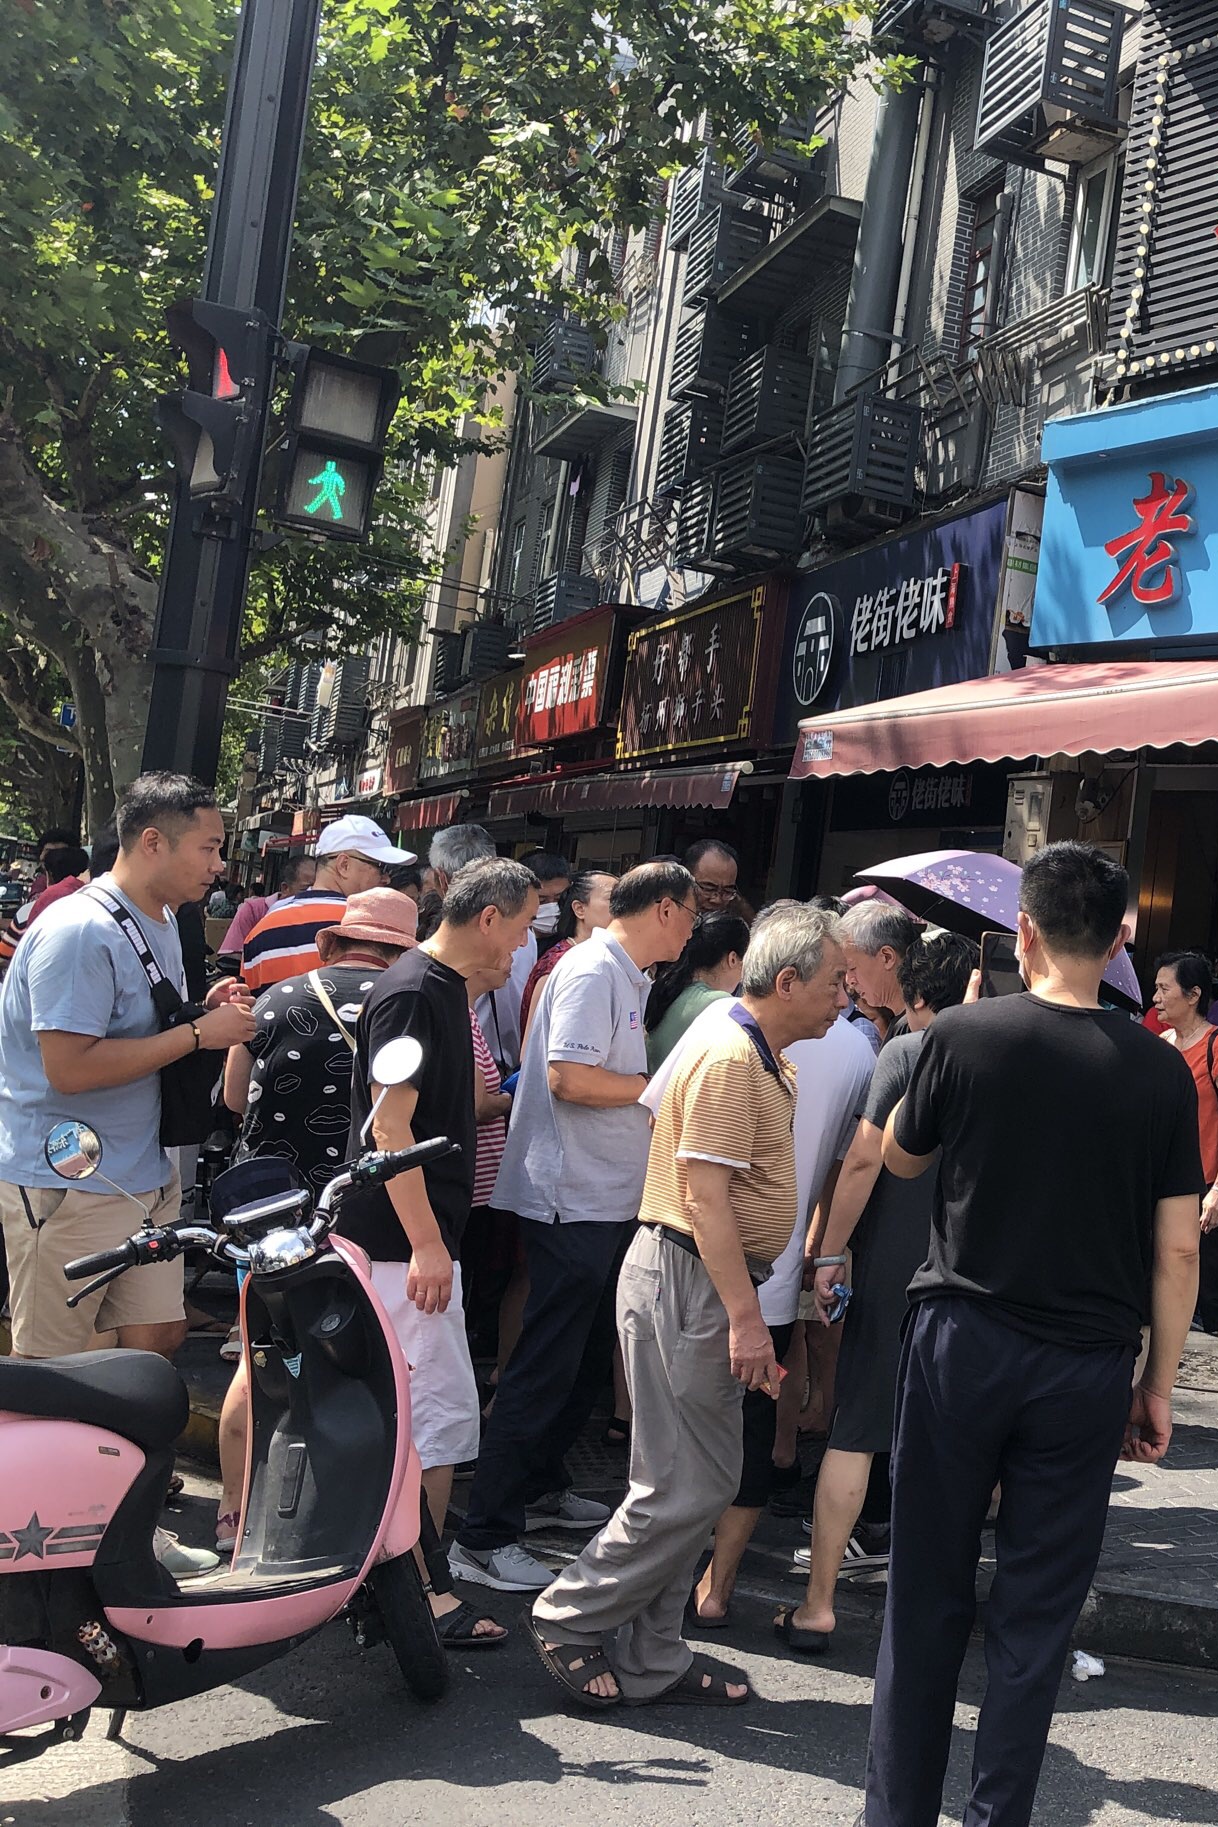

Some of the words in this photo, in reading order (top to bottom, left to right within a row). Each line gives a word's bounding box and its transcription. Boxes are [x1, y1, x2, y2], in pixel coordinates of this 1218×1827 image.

[850, 567, 948, 657] 佬街佬味
[525, 649, 599, 715] 中国福利彩票
